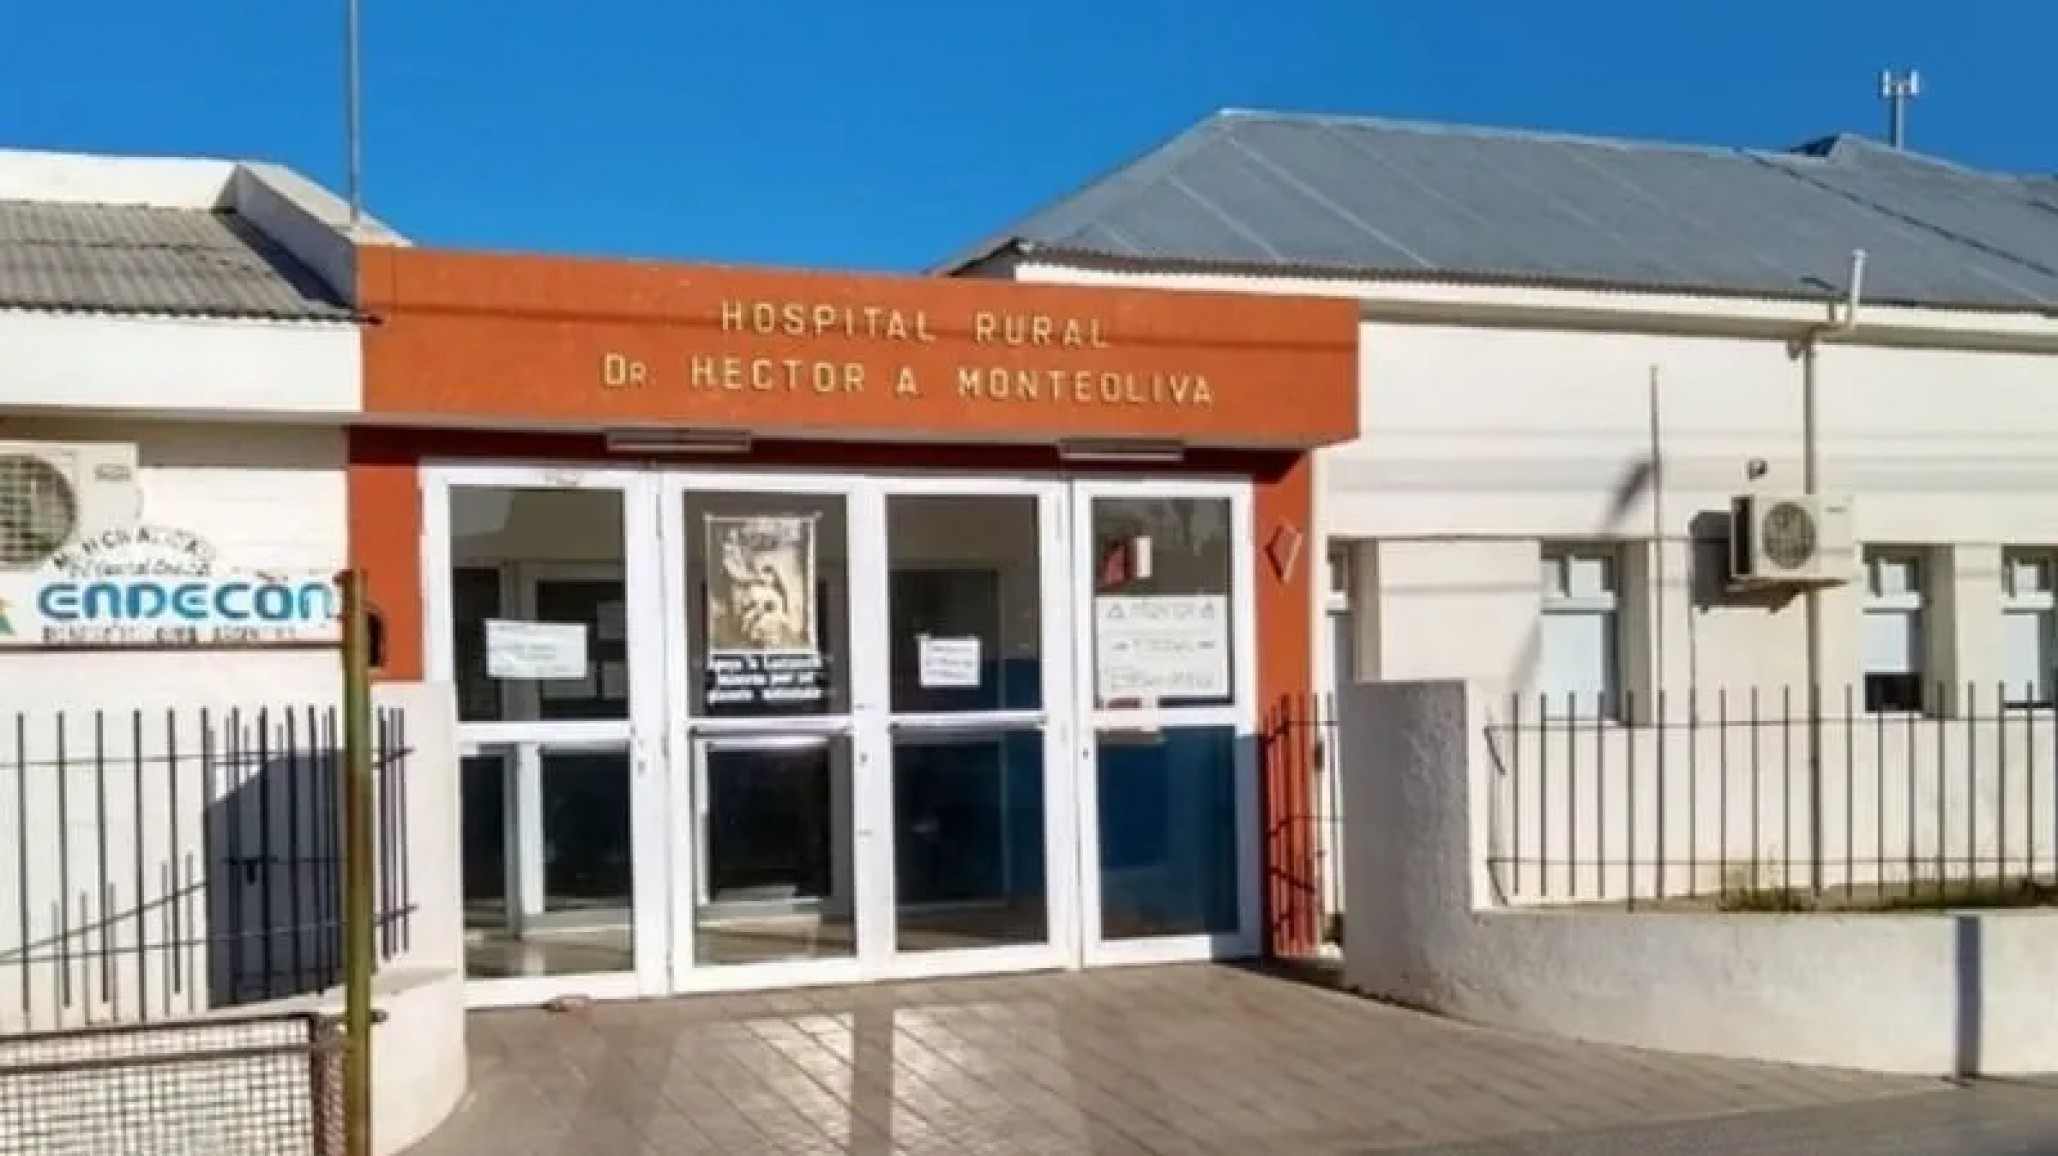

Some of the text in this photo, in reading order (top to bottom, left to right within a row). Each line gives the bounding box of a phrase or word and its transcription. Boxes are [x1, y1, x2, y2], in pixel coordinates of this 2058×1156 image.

[721, 299, 1111, 349] HOSPITAL RURAL
[690, 354, 865, 393] HECTOR
[896, 367, 917, 396] A
[957, 367, 1214, 405] MONTEOLIVA
